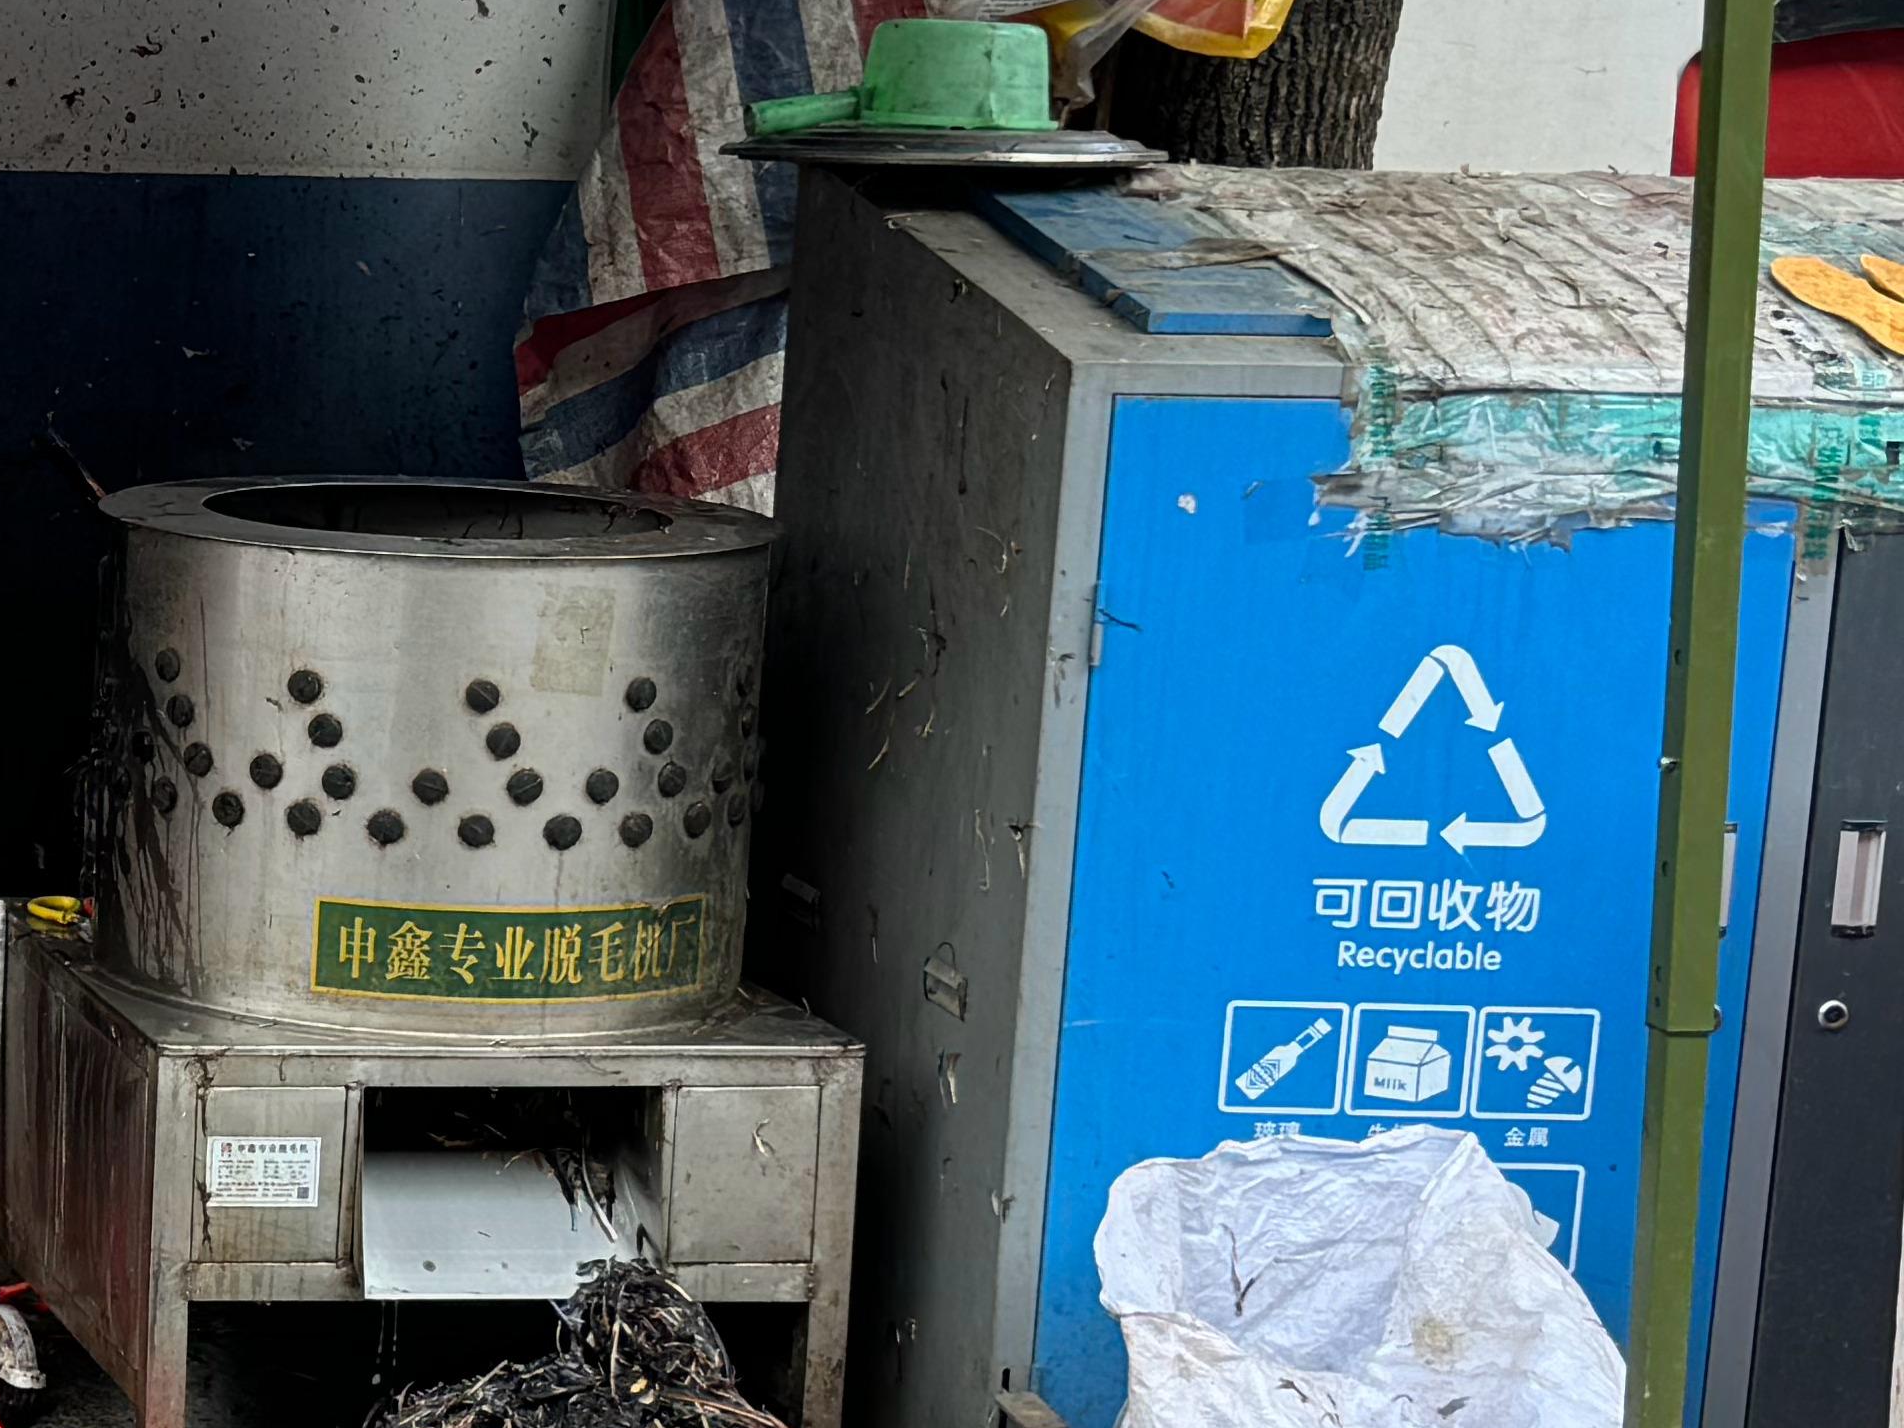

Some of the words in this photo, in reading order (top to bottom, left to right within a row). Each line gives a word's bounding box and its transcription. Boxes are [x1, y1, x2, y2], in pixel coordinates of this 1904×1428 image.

[1312, 878, 1541, 933] 可回收物
[338, 914, 697, 986] 申鑫专业脱毛机厂
[1337, 940, 1502, 975] Recyclable
[1503, 1126, 1549, 1148] 金属
